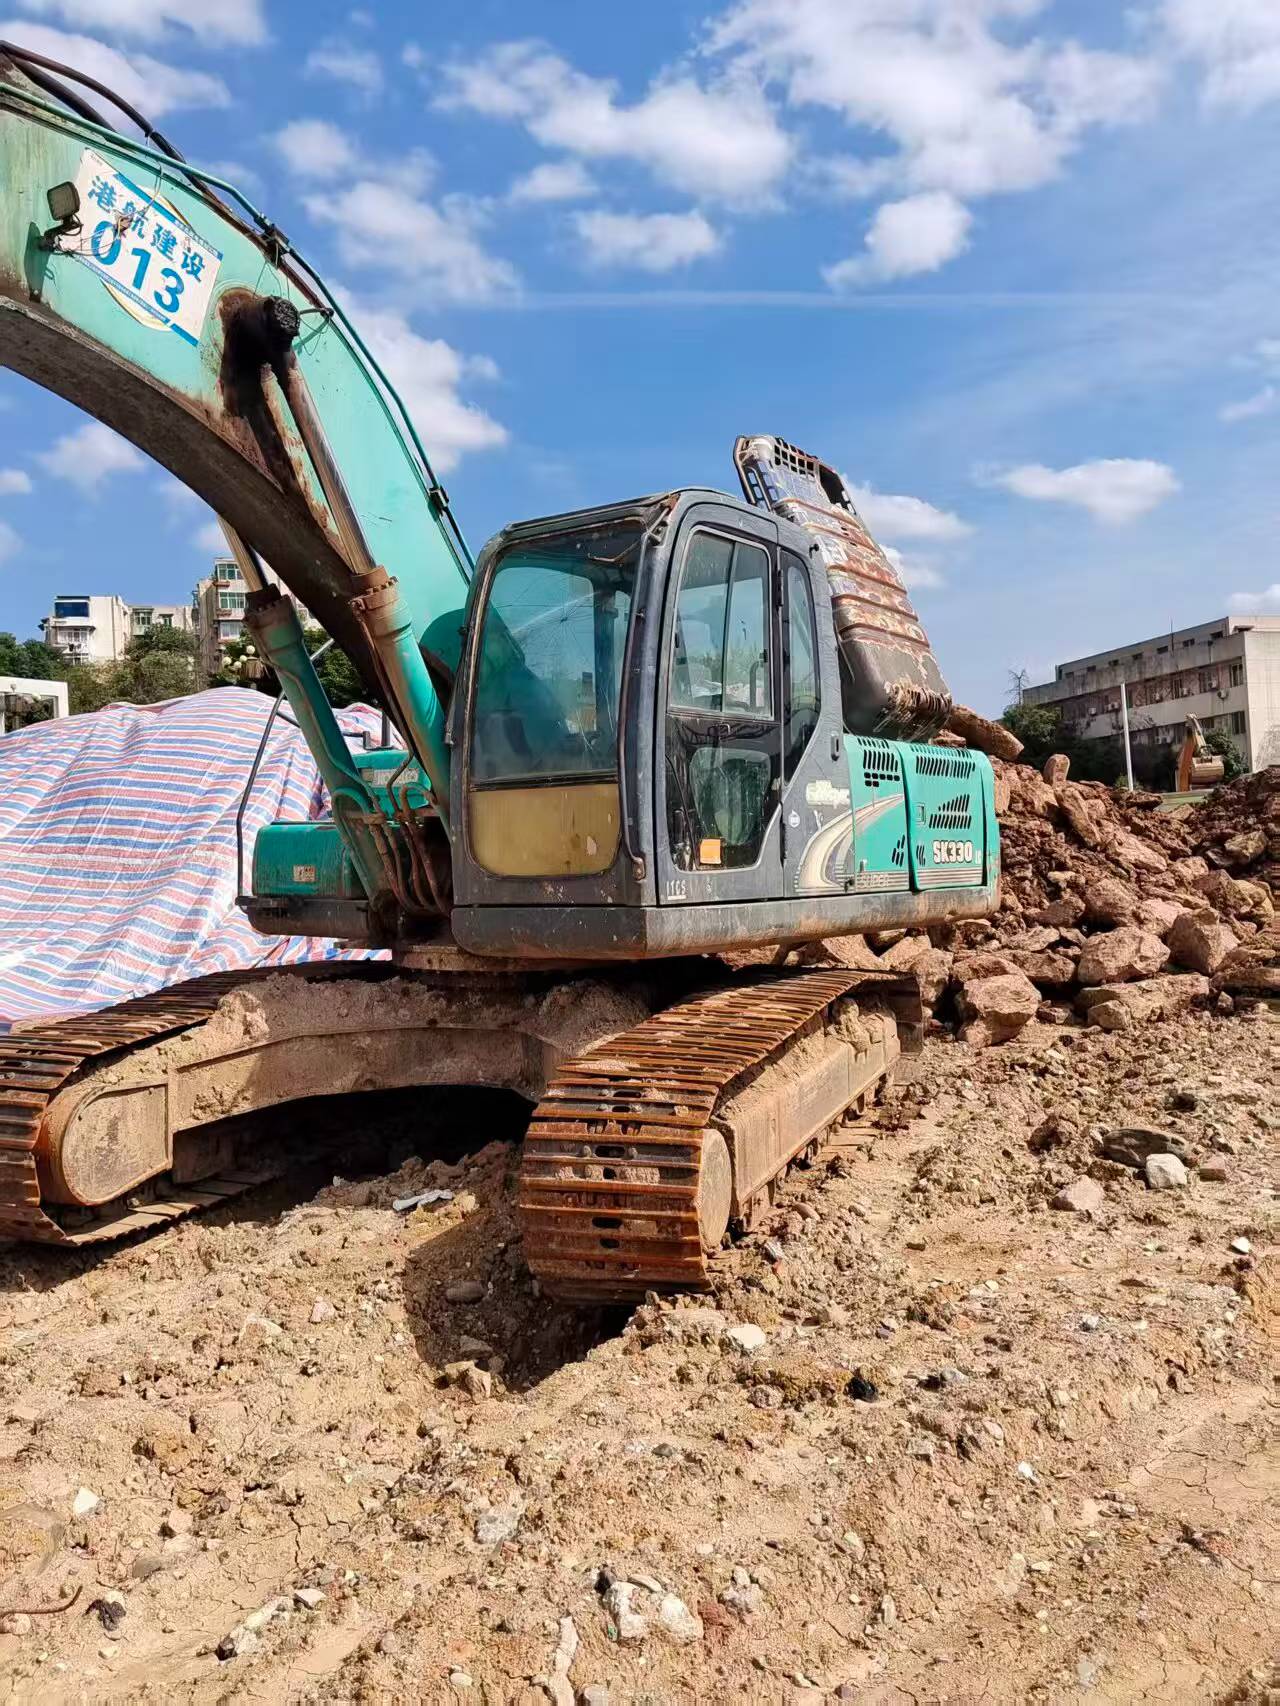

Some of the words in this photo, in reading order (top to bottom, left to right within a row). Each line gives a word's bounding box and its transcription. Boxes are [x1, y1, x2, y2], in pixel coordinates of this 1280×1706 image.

[88, 175, 206, 283] 港航建设
[91, 220, 185, 313] 013
[933, 840, 973, 864] SK330
